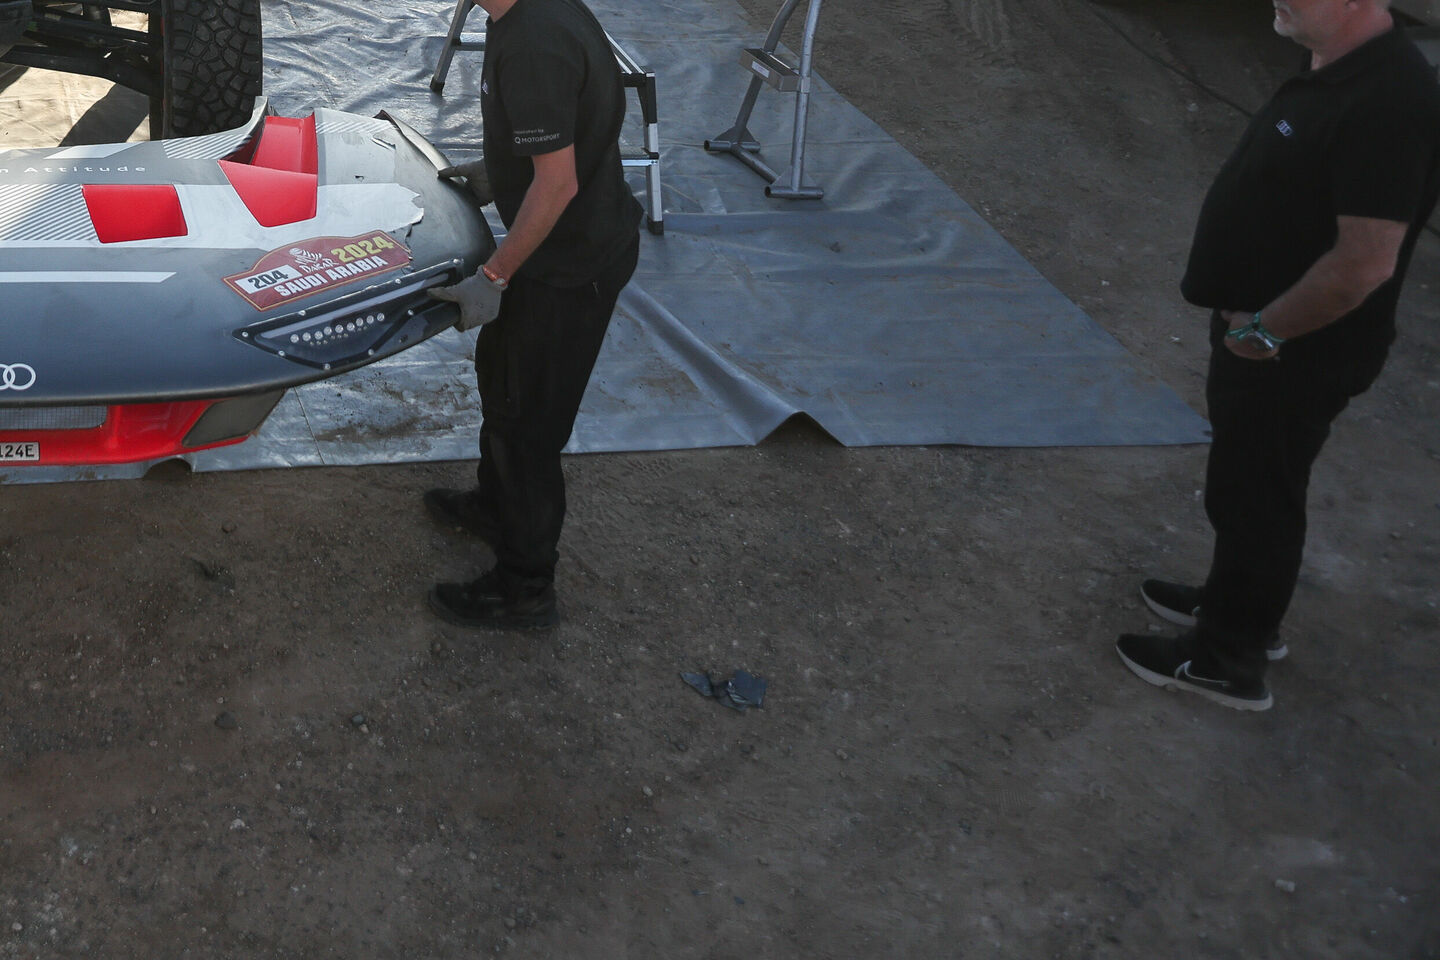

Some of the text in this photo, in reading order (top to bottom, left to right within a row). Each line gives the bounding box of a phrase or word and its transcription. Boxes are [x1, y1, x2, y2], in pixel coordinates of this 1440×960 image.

[521, 133, 560, 143] MOTORSPORT
[24, 164, 147, 175] Attitude
[330, 236, 395, 263] 2024
[299, 257, 340, 273] DAKAR
[247, 269, 289, 290] 204
[273, 255, 389, 298] SAUDI ARABIA
